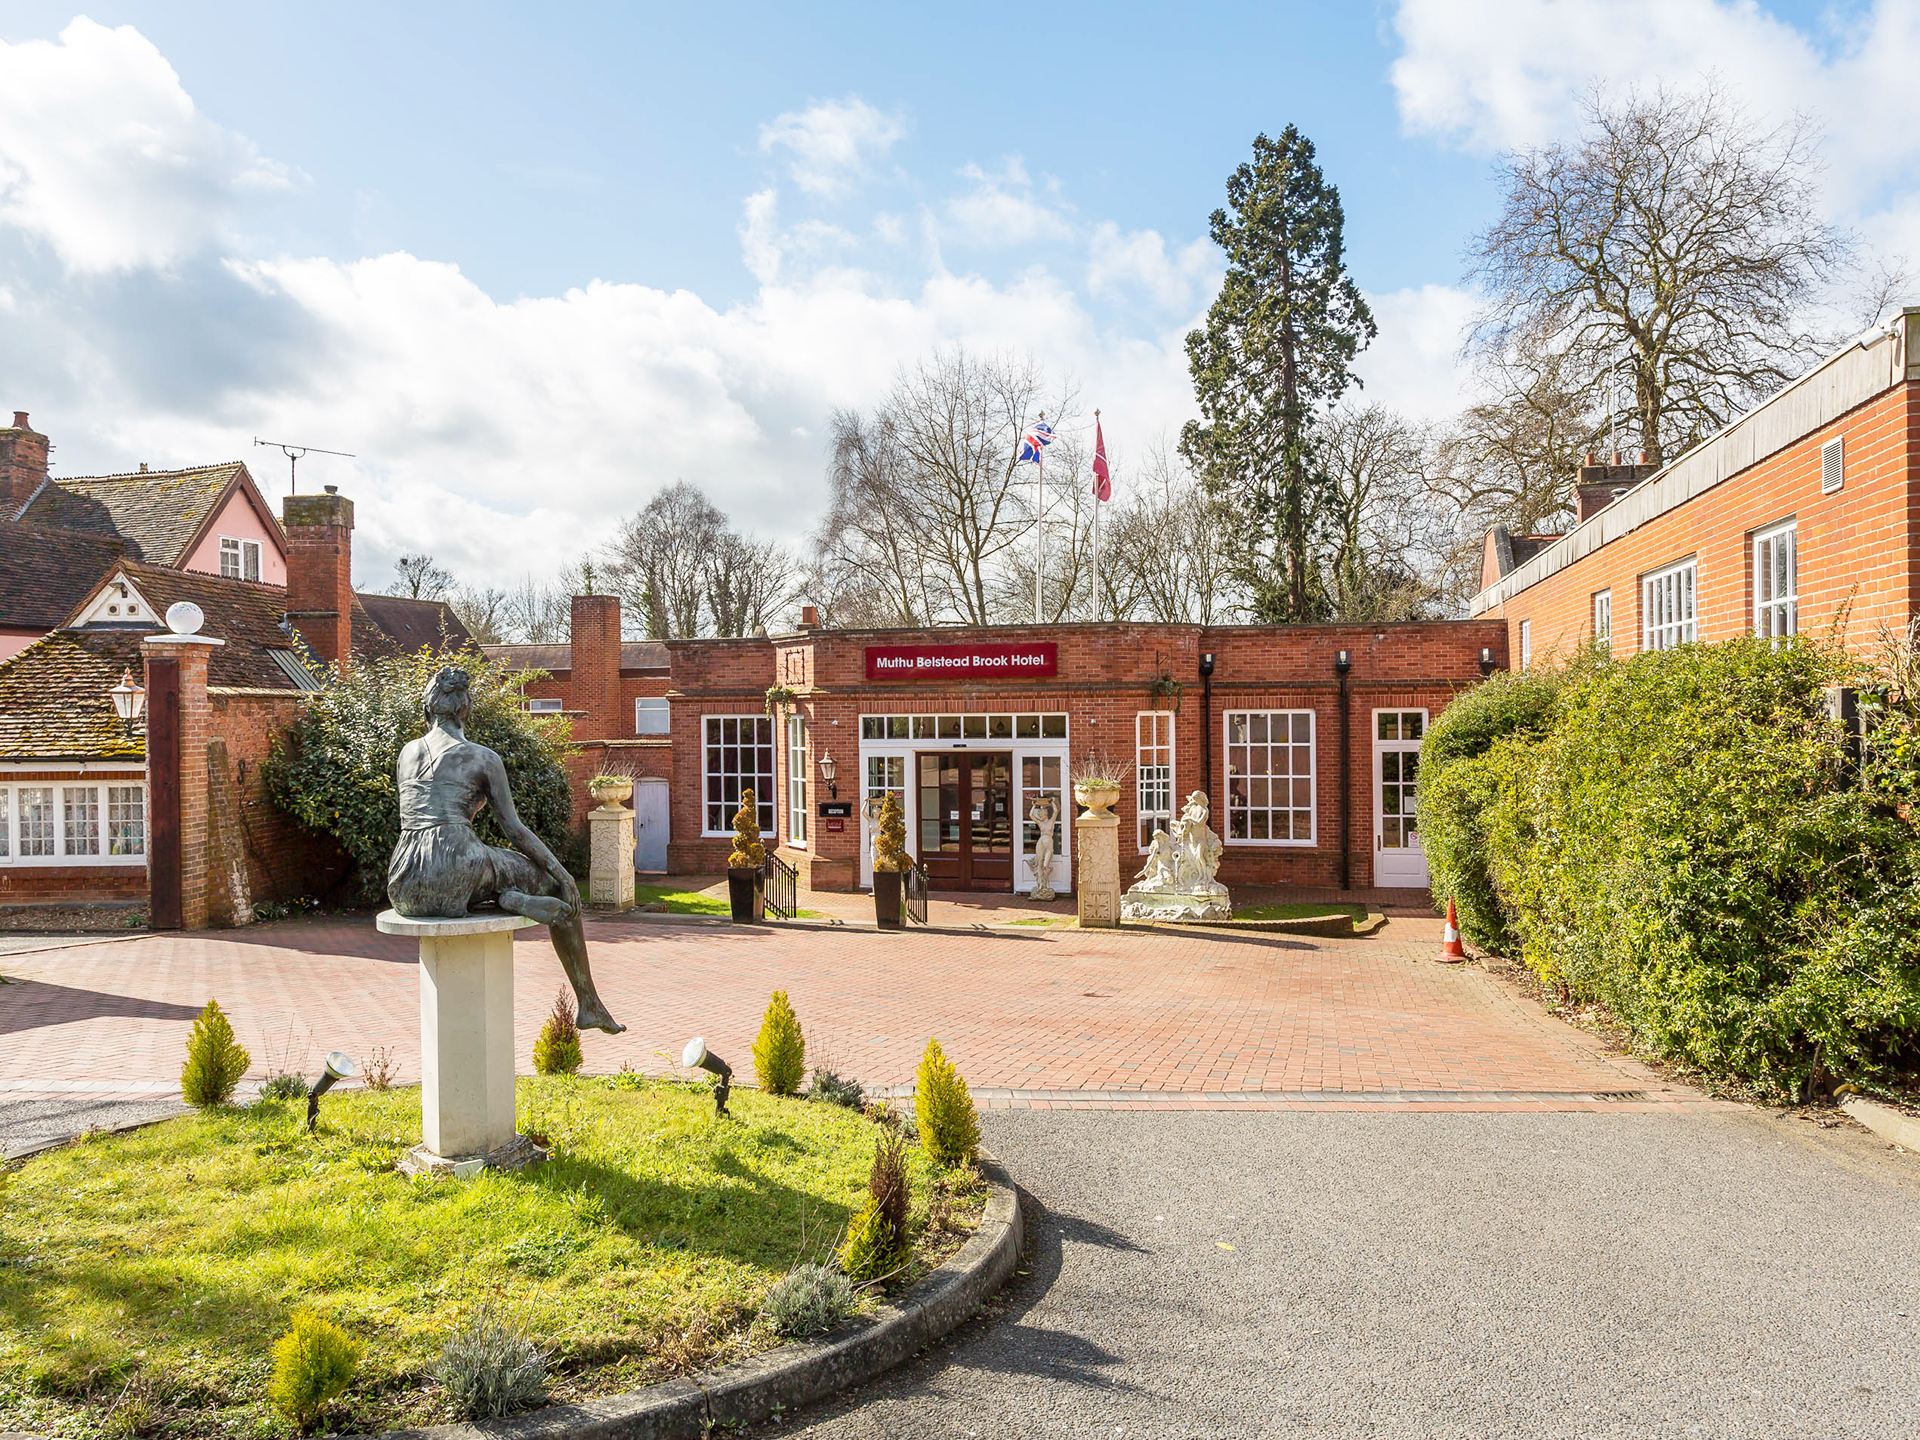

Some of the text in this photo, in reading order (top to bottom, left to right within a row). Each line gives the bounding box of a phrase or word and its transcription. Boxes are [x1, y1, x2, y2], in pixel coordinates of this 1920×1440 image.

[876, 654, 1044, 668] Muthu Belstead Brook Hotel
